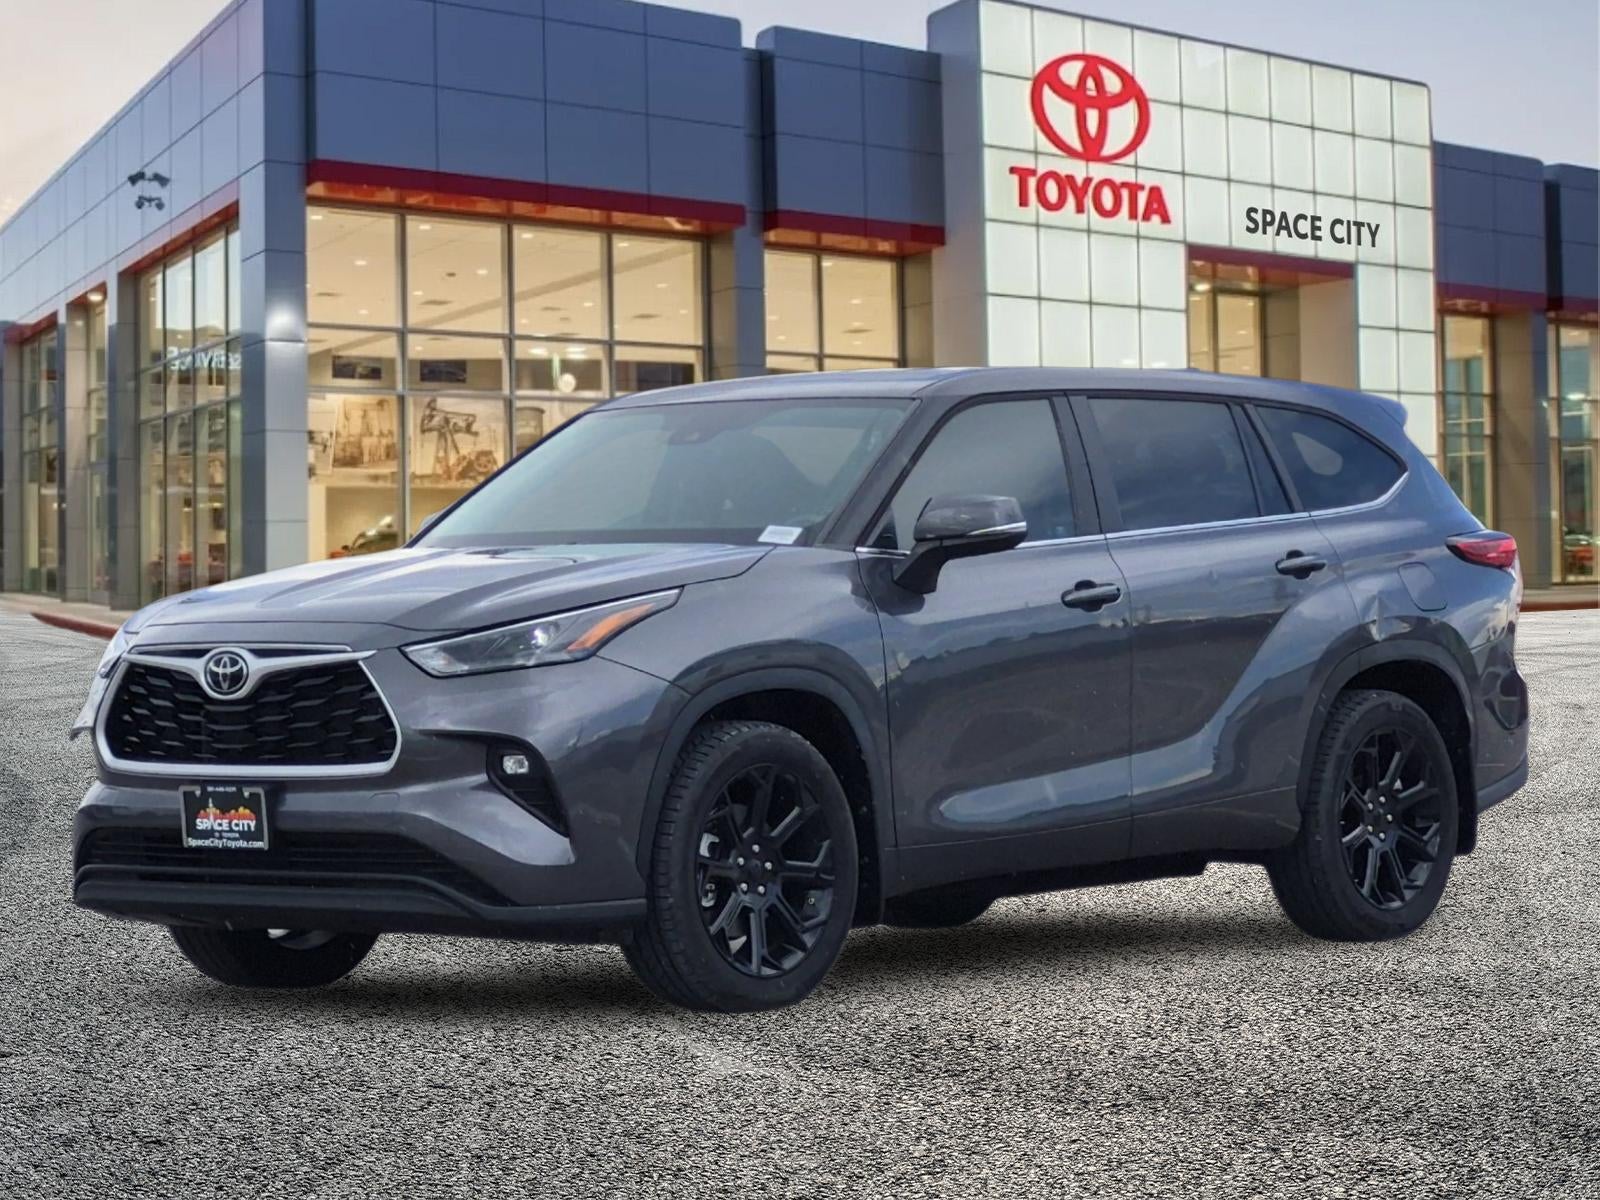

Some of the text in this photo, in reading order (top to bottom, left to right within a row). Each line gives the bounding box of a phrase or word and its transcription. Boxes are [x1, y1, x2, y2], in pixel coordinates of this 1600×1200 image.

[1010, 166, 1172, 224] TOYOTA
[1245, 207, 1380, 248] SPACE CITY
[196, 818, 256, 832] SPACE CITY
[188, 838, 264, 848] SpaceCityToyota.com
